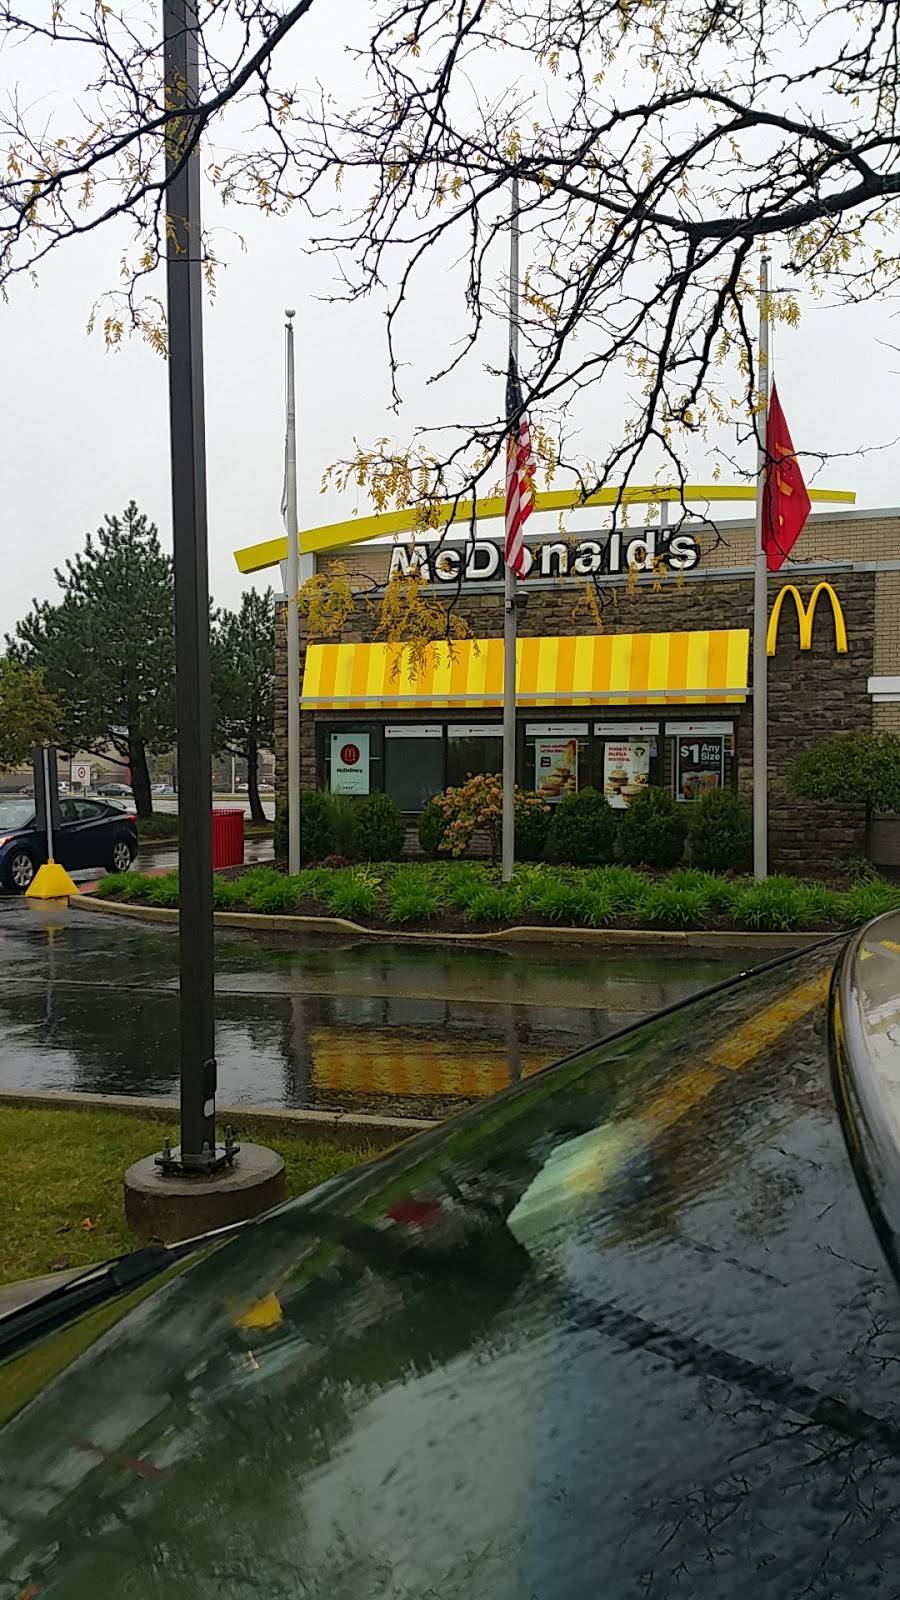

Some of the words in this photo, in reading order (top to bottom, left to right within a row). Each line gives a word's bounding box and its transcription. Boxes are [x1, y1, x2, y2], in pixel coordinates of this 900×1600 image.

[701, 743, 721, 753] Any
[680, 744, 700, 763] $1
[701, 752, 721, 761] Size
